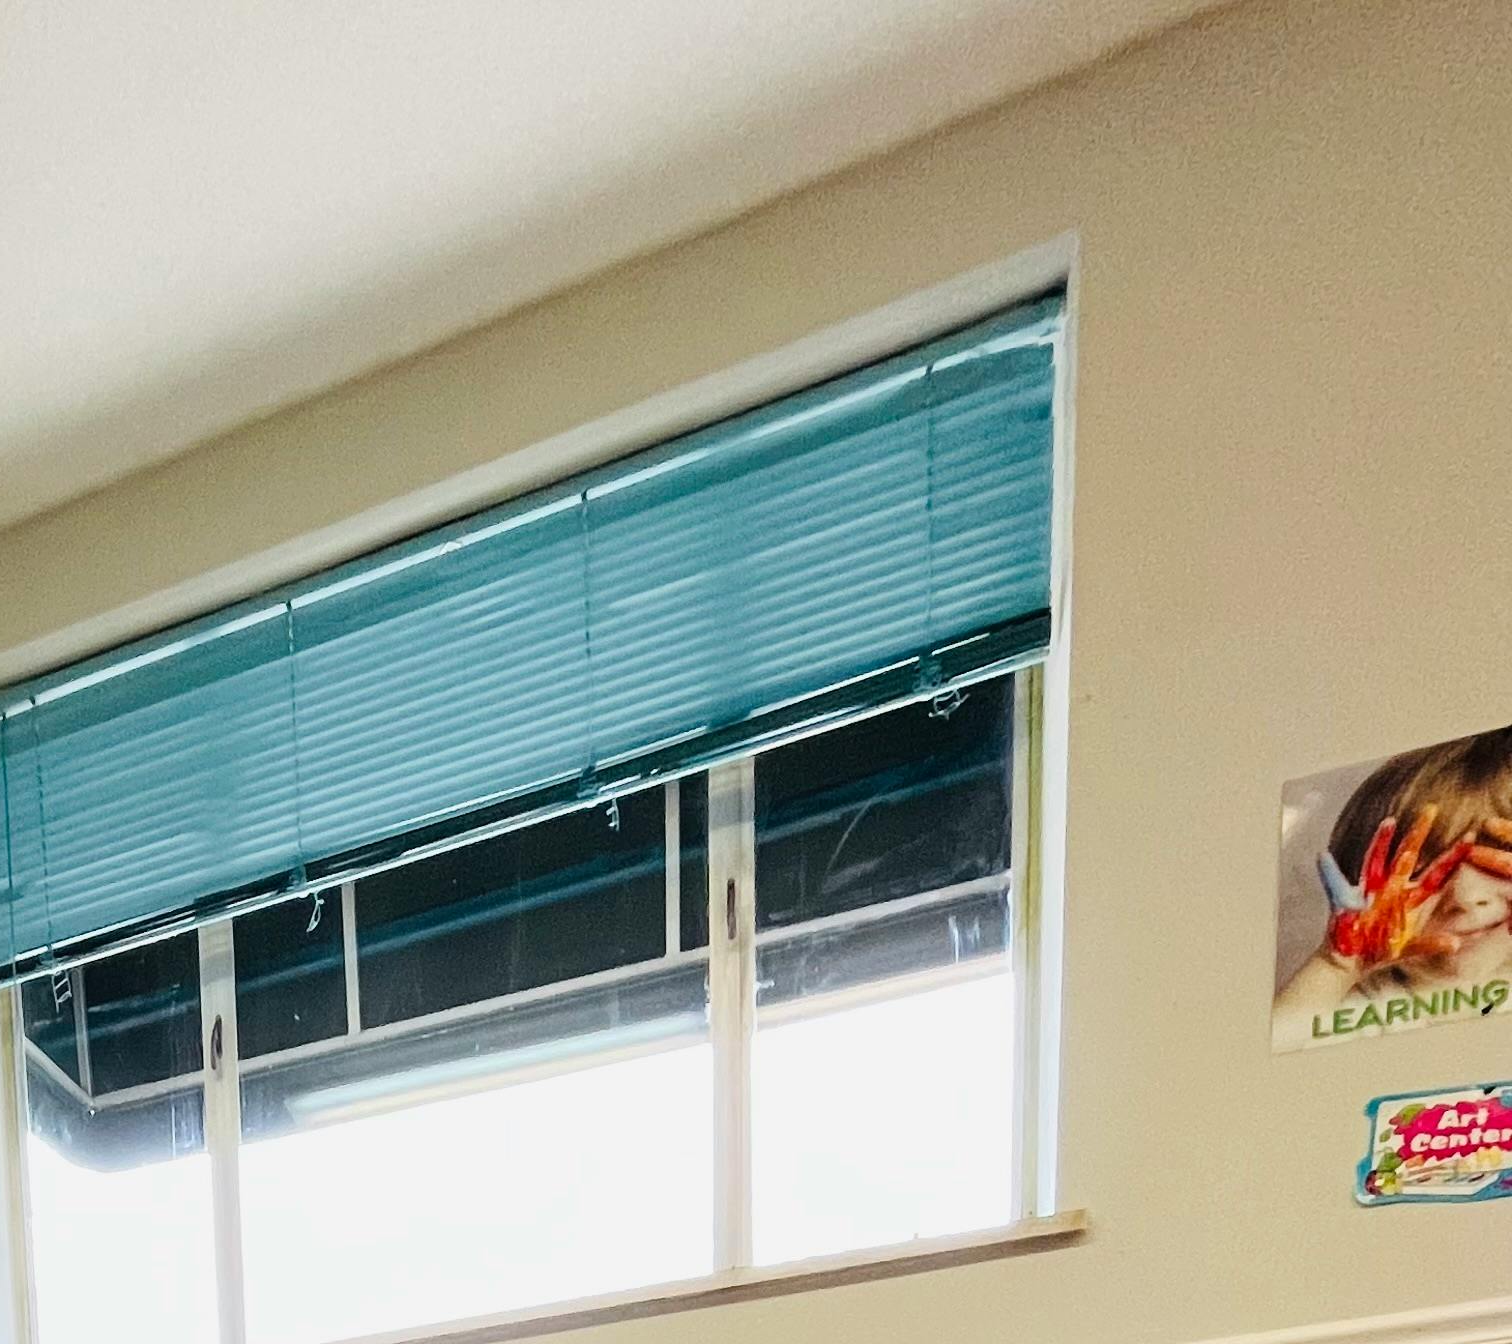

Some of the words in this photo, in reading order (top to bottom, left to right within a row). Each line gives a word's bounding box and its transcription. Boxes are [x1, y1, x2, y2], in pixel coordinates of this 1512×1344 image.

[1312, 979, 1510, 1039] LEARNING
[1437, 1107, 1489, 1130] Art
[1410, 1127, 1512, 1153] Center
